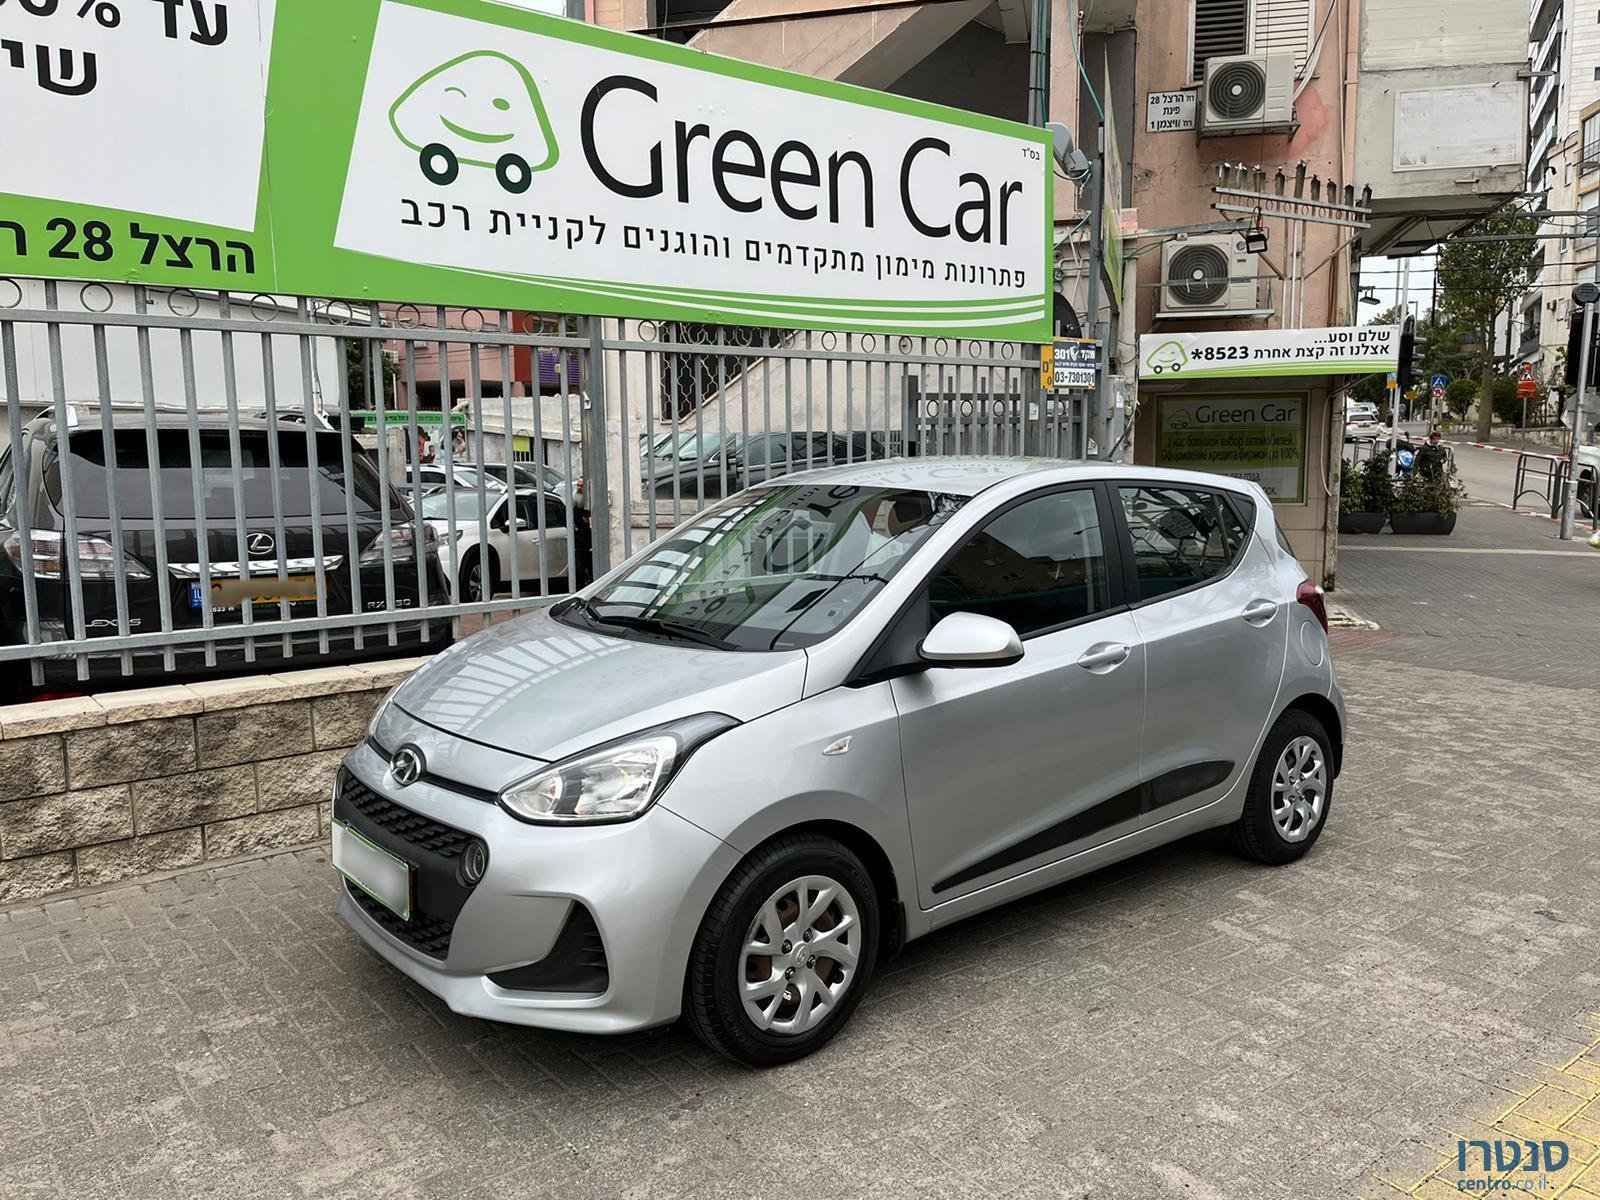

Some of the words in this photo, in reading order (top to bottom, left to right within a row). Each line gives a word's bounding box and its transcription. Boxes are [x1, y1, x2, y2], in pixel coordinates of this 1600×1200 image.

[1151, 96, 1160, 104] 28
[1163, 93, 1184, 104] הרצל
[1163, 106, 1180, 115] פינת
[580, 74, 874, 229] Green
[899, 137, 1023, 246] Car
[1021, 147, 1040, 161] בס"ד
[401, 198, 470, 231] רכב
[488, 209, 606, 250] לקניית
[46, 217, 114, 262] 28
[623, 225, 730, 259] והוגנים
[129, 222, 255, 275] הרצל
[745, 239, 865, 275] מתקדמים
[875, 254, 935, 281] מימון
[944, 262, 1025, 289] פתרונות
[1359, 330, 1390, 342] שלם
[1054, 348, 1070, 360] 301
[1253, 348, 1292, 359] אחרת
[1295, 347, 1325, 360] קצת
[1329, 346, 1346, 357] זה
[1350, 343, 1390, 356] אצלנו
[1195, 405, 1255, 424] Green
[1260, 403, 1296, 423] Car
